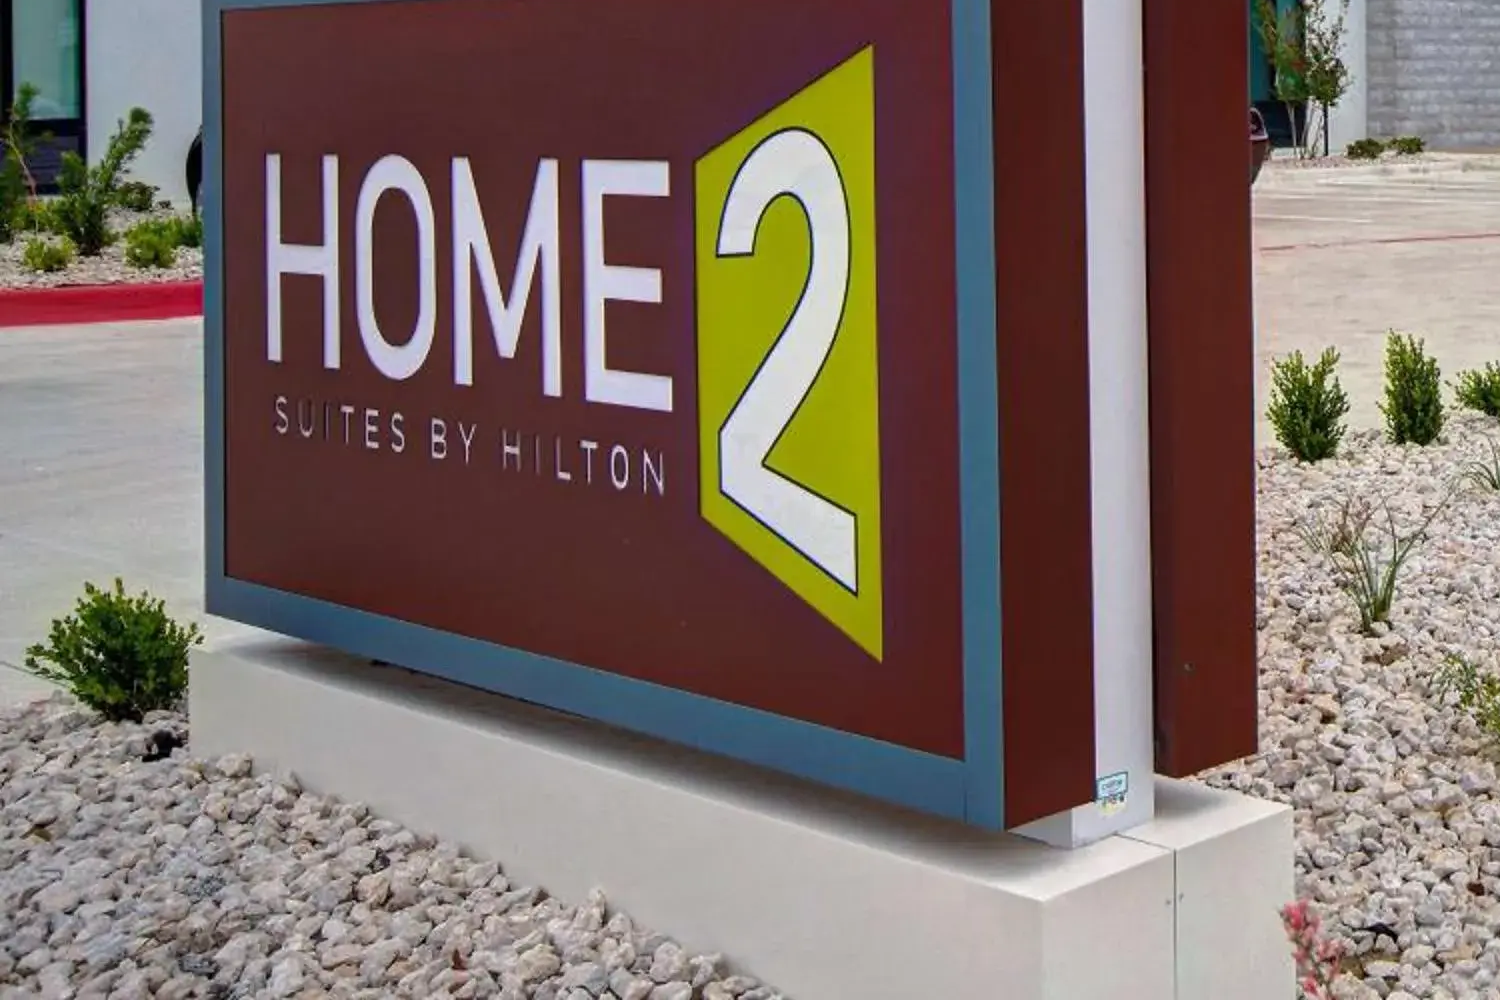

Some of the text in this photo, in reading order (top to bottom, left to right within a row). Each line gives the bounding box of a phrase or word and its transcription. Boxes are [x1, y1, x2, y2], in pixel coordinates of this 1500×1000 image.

[265, 126, 858, 598] HOME 2
[274, 395, 666, 496] SUITES BY HILTON
